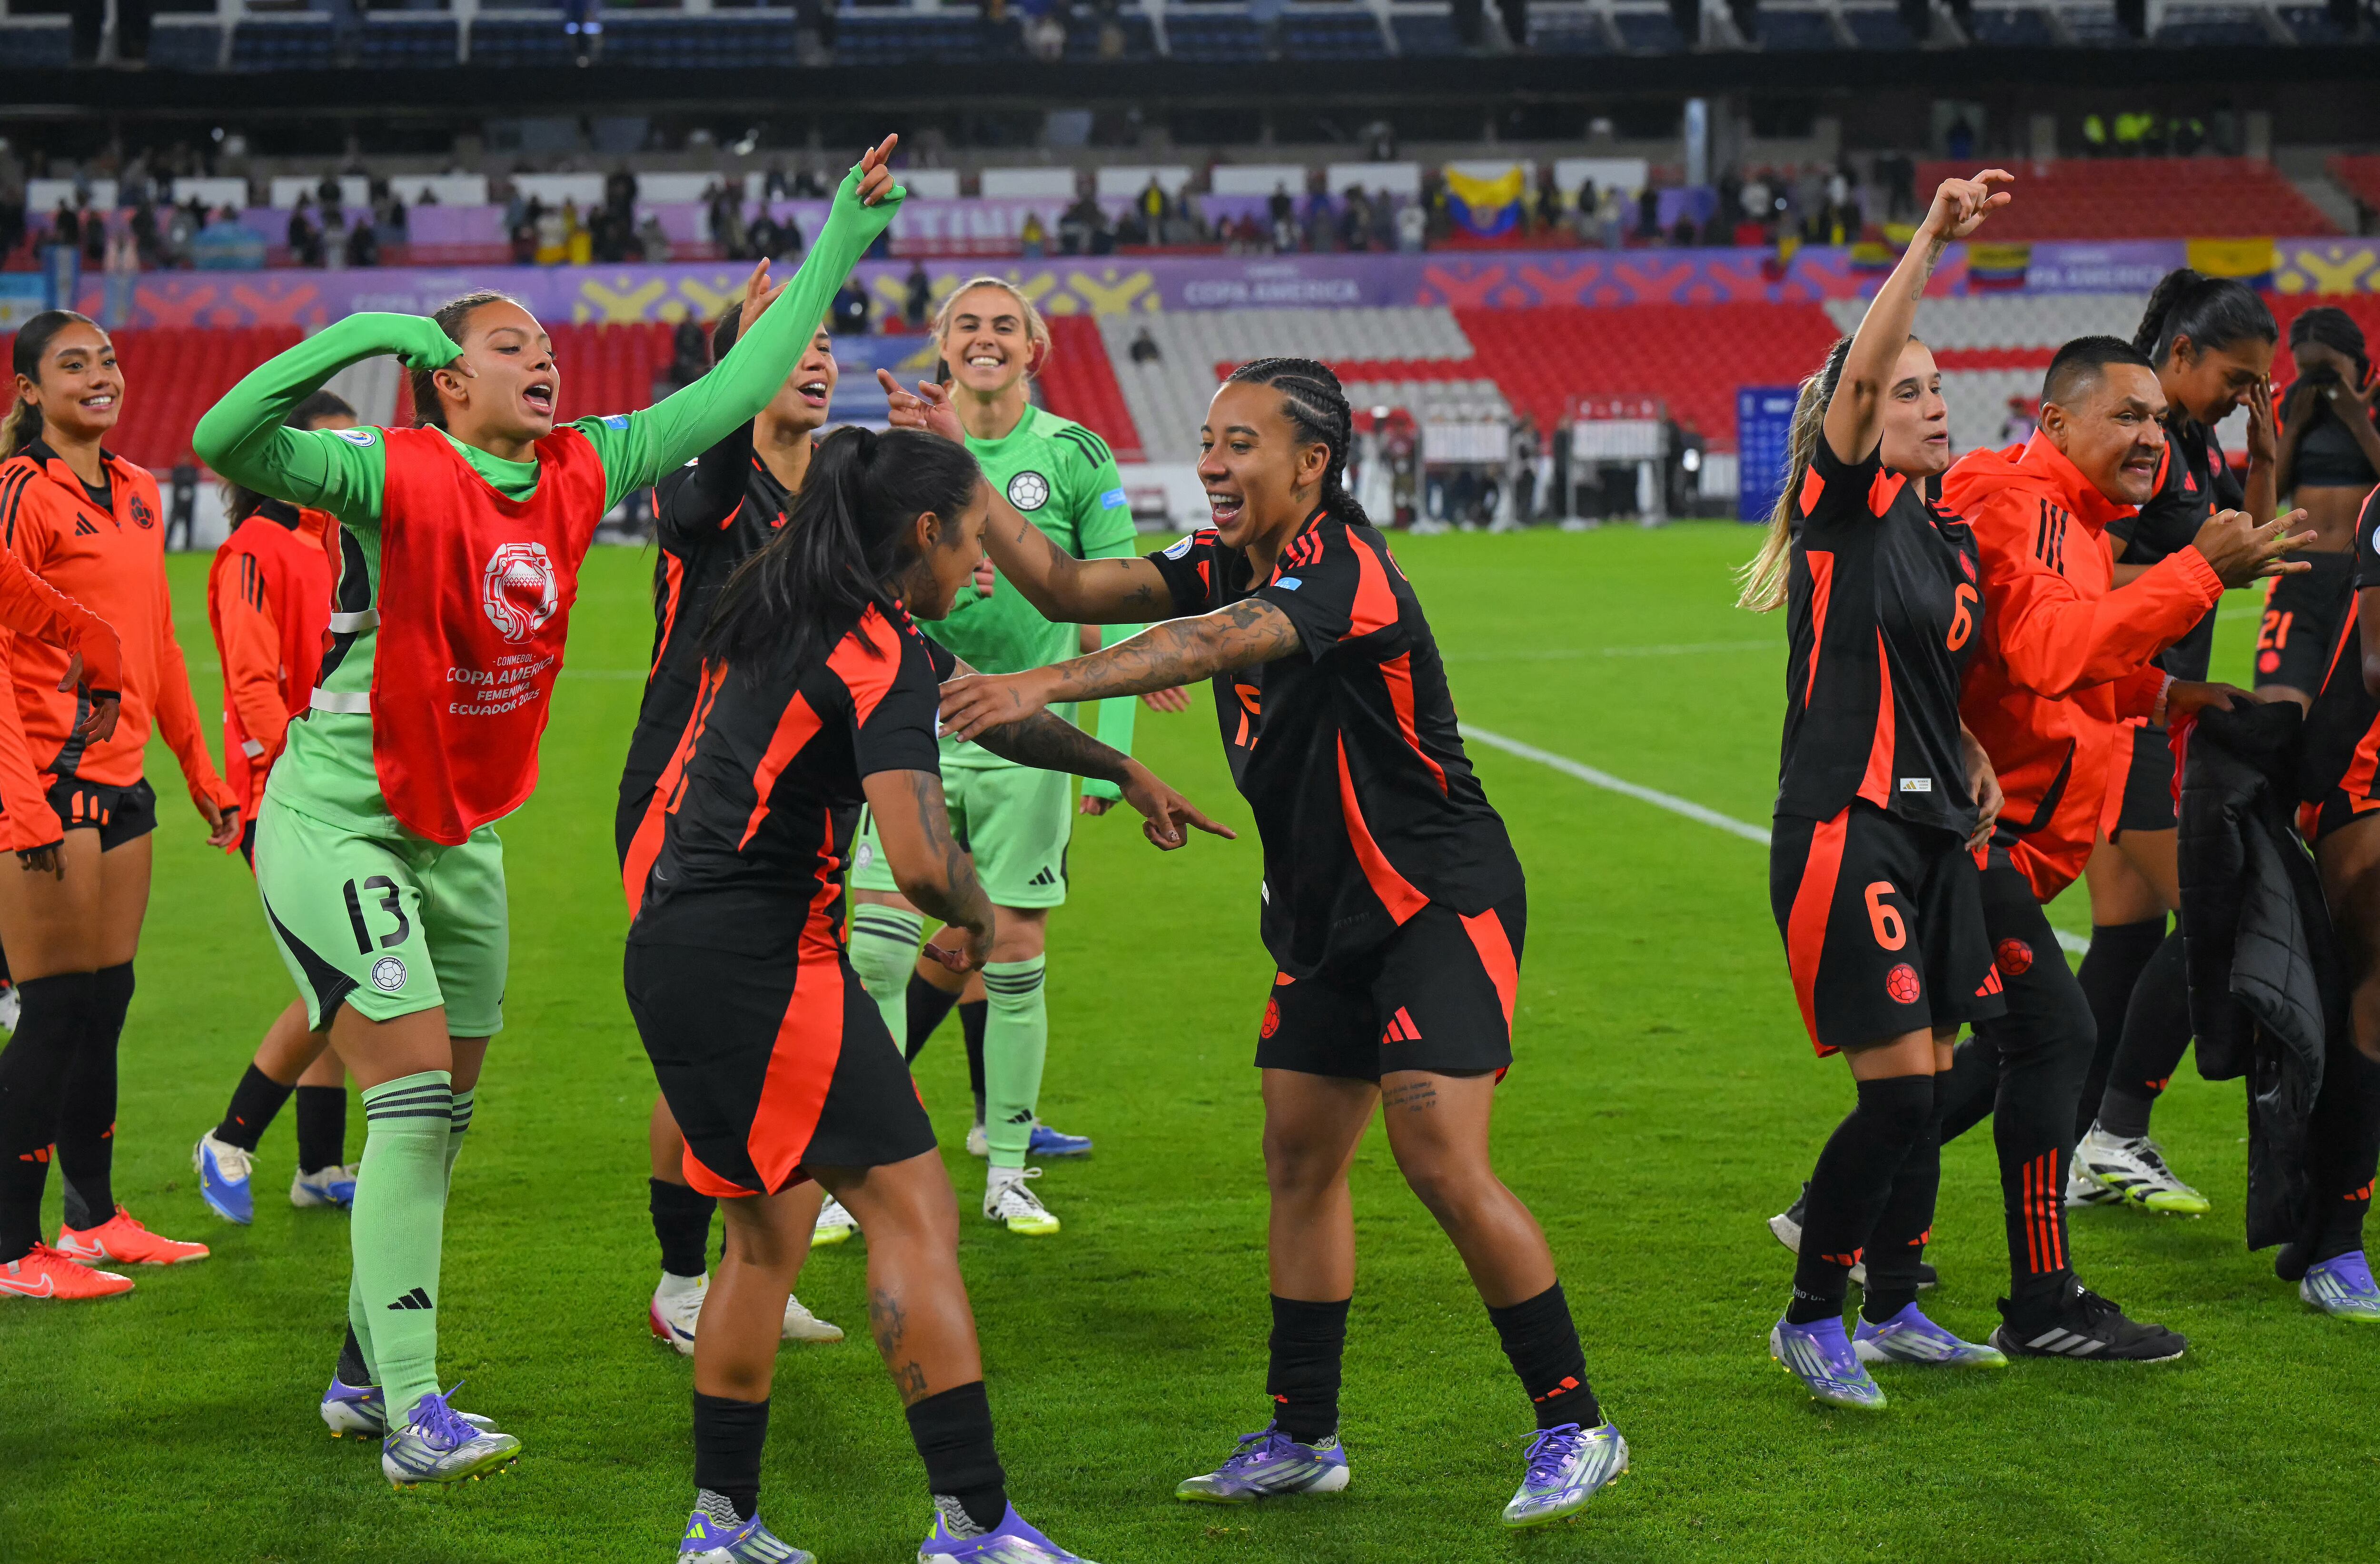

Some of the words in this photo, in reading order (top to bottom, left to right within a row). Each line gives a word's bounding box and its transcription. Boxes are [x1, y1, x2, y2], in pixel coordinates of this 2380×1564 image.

[1946, 583, 1978, 652] 6
[2257, 610, 2294, 650] 21
[447, 667, 494, 685] COPA
[497, 653, 554, 684] AMERICA
[449, 699, 517, 715] ECUADOR
[518, 688, 540, 706] 2025
[477, 682, 530, 701] FEMENINA
[343, 875, 410, 955] 13
[1864, 881, 1906, 951] 6
[2329, 1298, 2377, 1310] F50
[1814, 1379, 1868, 1398] F50
[1521, 1488, 1583, 1511] F50
